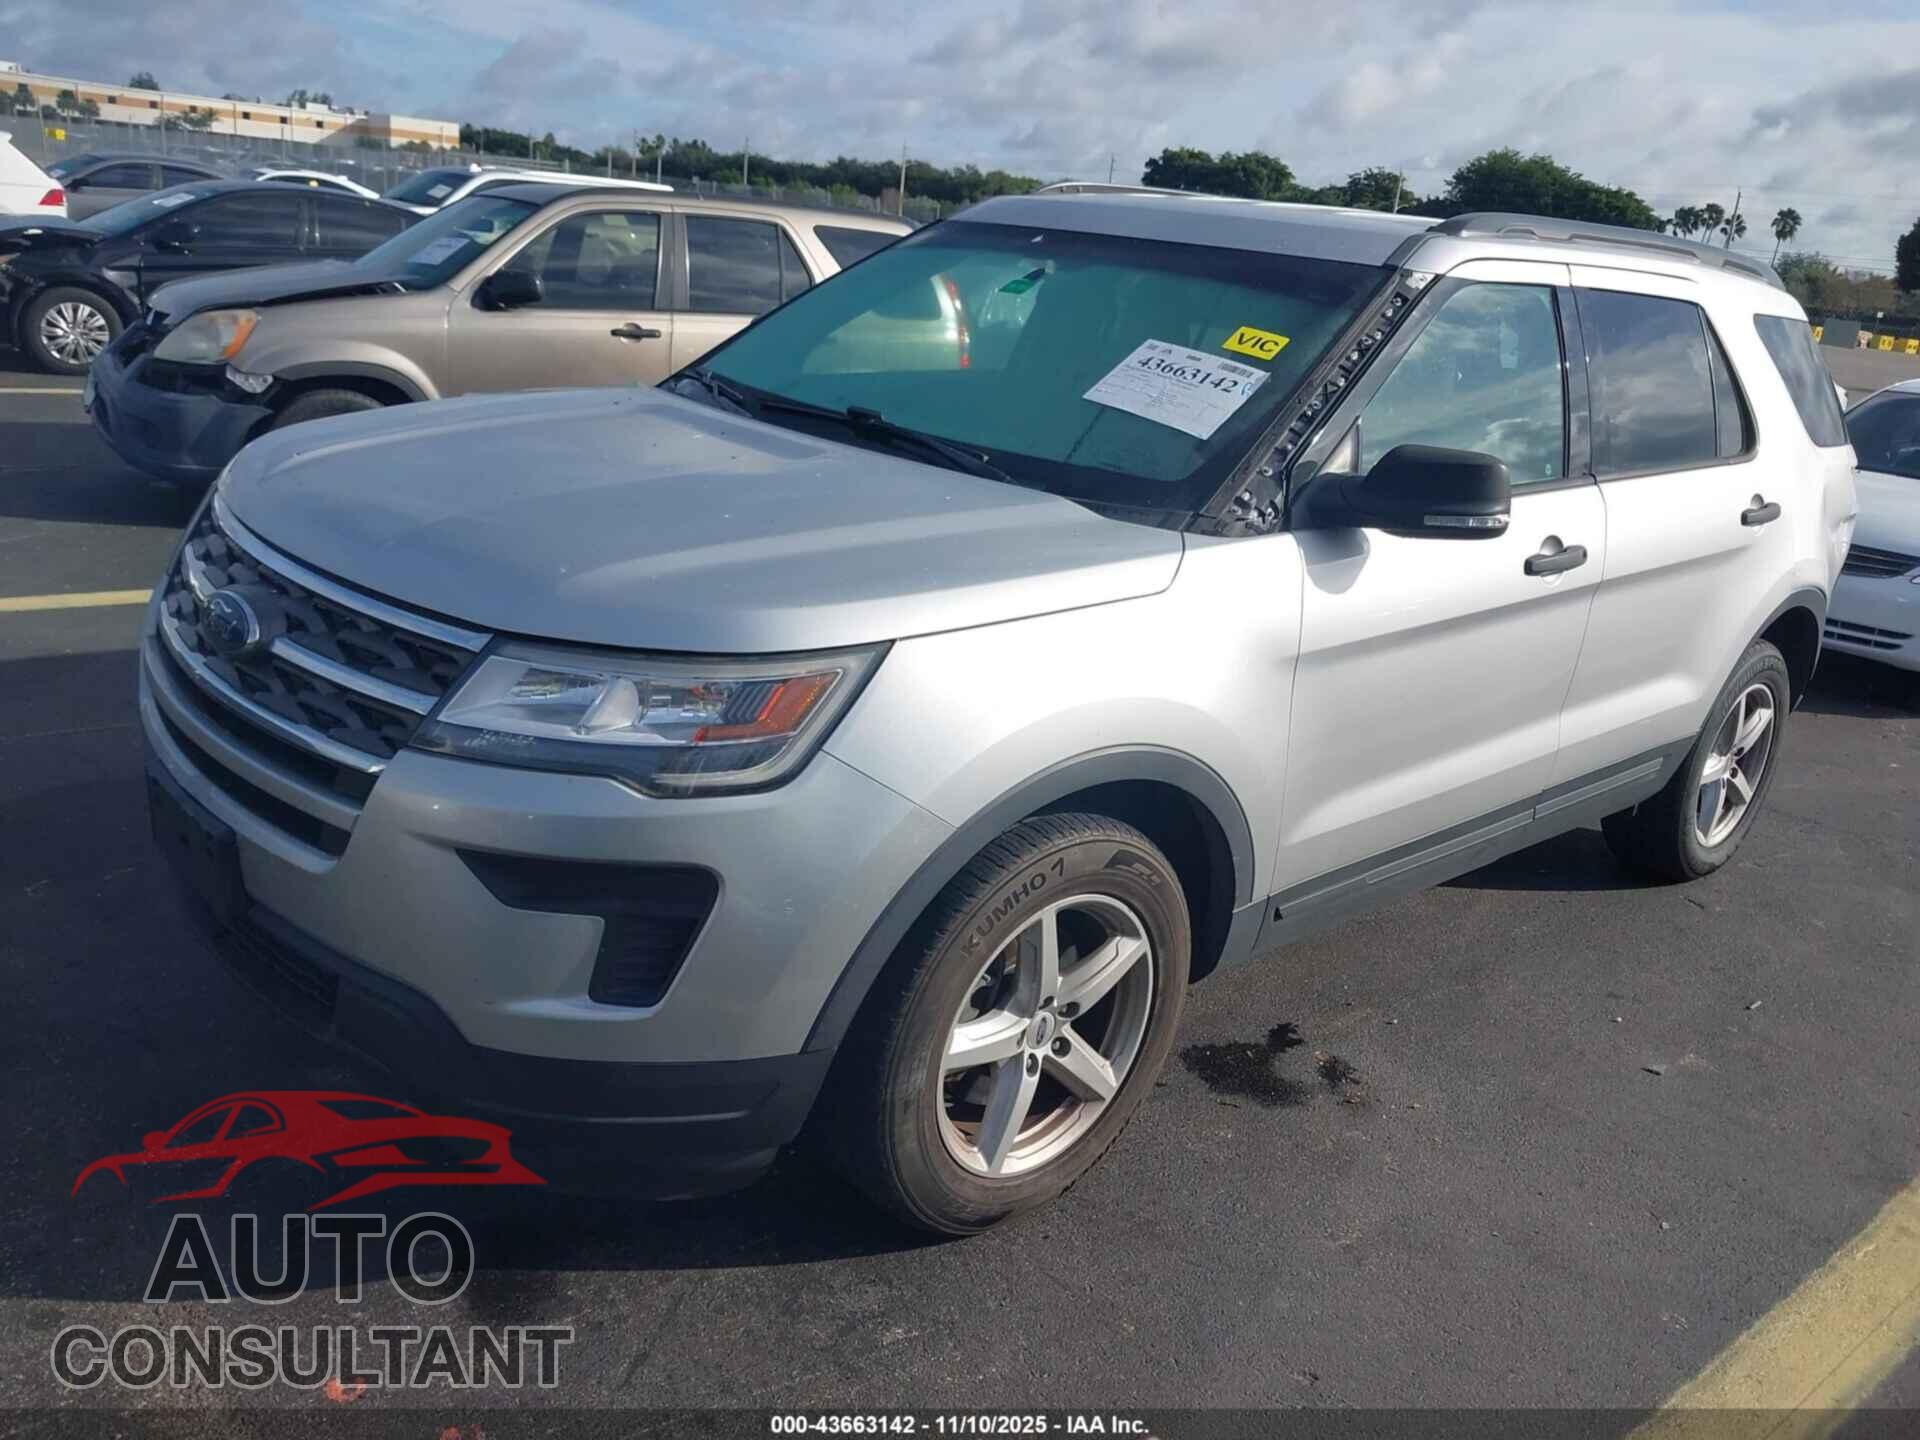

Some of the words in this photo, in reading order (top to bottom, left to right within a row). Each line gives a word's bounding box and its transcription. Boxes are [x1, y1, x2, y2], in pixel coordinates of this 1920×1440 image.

[1236, 331, 1280, 354] VIC
[1137, 355, 1239, 394] 43663142
[960, 871, 1047, 959] KUMHO
